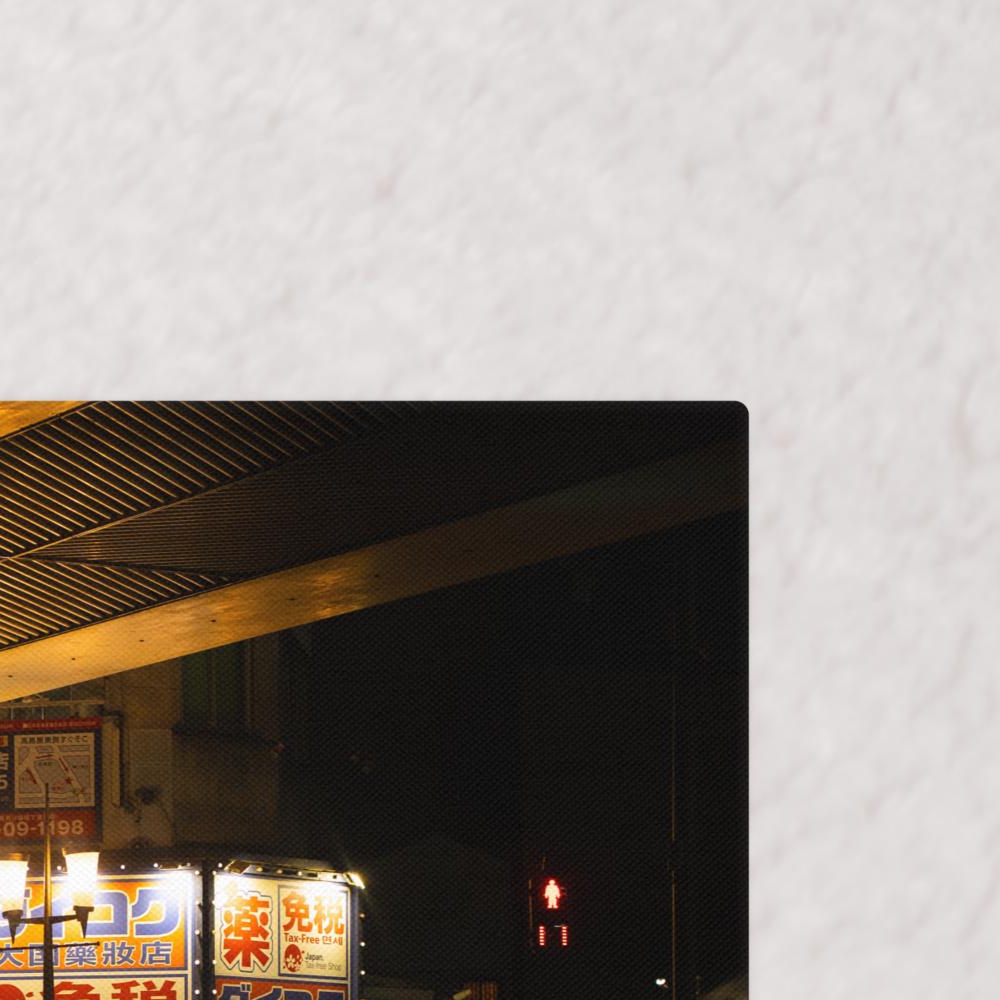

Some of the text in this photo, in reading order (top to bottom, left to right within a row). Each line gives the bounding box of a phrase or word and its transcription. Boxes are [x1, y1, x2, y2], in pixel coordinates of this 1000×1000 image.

[223, 893, 270, 968] 薬
[282, 891, 344, 935] 免税
[284, 933, 320, 944] Tax-Free
